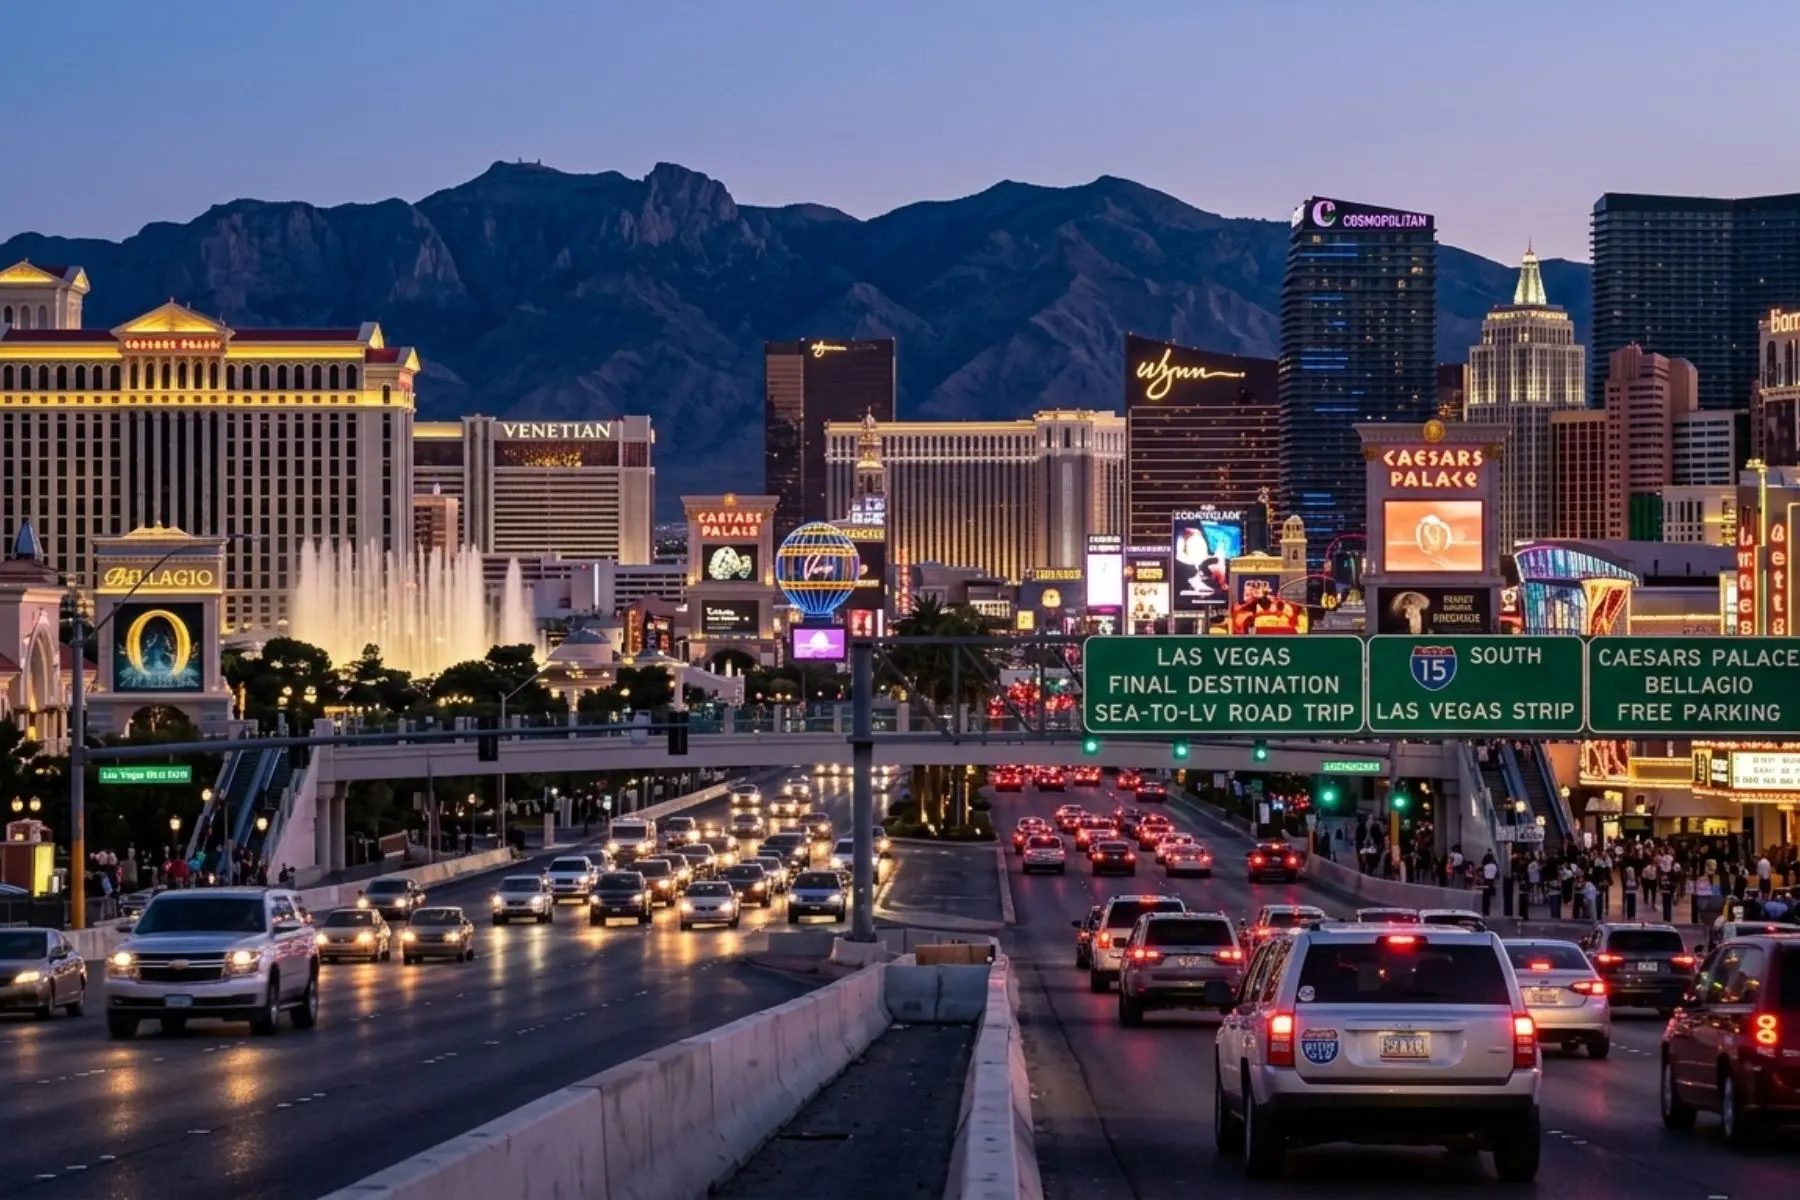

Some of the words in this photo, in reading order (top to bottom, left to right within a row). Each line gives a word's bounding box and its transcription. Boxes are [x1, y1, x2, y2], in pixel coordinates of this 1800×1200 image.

[1343, 214, 1428, 229] COSMOPOLITAN
[1136, 348, 1245, 401] wynn
[502, 422, 612, 439] VENETIAN
[1383, 449, 1483, 467] CAESARS
[1391, 470, 1478, 488] PALACE
[1158, 647, 1203, 666] LAS
[1214, 647, 1290, 666] VEGAS
[1470, 646, 1541, 664] SOUTH
[1599, 649, 1701, 666] CAESARS
[1712, 649, 1799, 667] PALACE
[1421, 659, 1446, 681] 15
[1109, 675, 1177, 694] FINAL
[1188, 675, 1339, 694] DESTINATION
[1645, 676, 1753, 694] BELLAGIO
[1095, 703, 1217, 722] SEA-TO-LV
[1229, 703, 1292, 722] ROAD
[1303, 703, 1354, 722] TRIP
[1377, 702, 1419, 720] LAS
[1430, 702, 1502, 720] VEGAS
[1513, 702, 1575, 720] STRIP
[1618, 703, 1672, 721] FREE
[1684, 703, 1780, 722] PARKING
